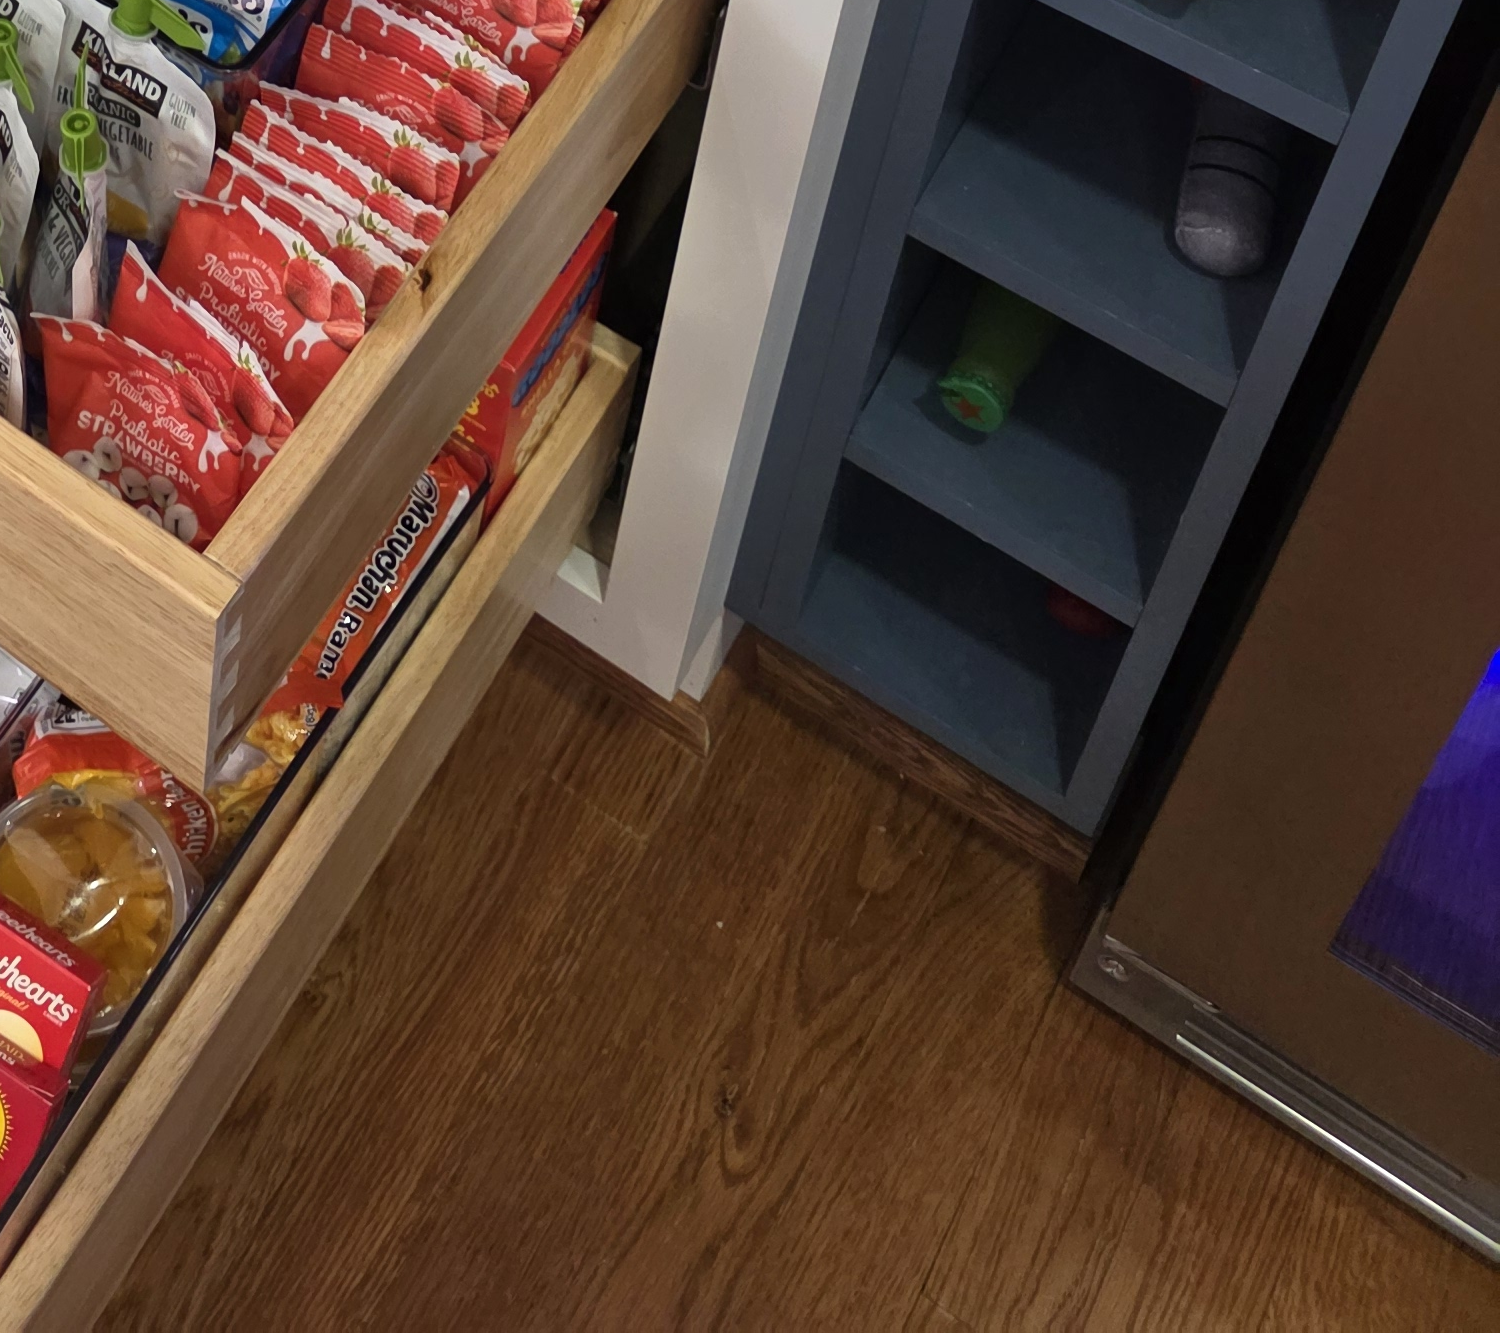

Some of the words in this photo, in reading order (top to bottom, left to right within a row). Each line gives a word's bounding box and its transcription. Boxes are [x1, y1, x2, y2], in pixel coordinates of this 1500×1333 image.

[459, 4, 502, 47] Garden
[197, 252, 247, 298] Nature's
[245, 287, 288, 338] Garden
[199, 280, 268, 352] Probiotic
[104, 370, 153, 414] Nature's
[152, 402, 196, 451] Garden
[109, 398, 182, 464] Probiotic
[77, 409, 201, 494] STRAWBERRY
[345, 486, 438, 613] Maruchan
